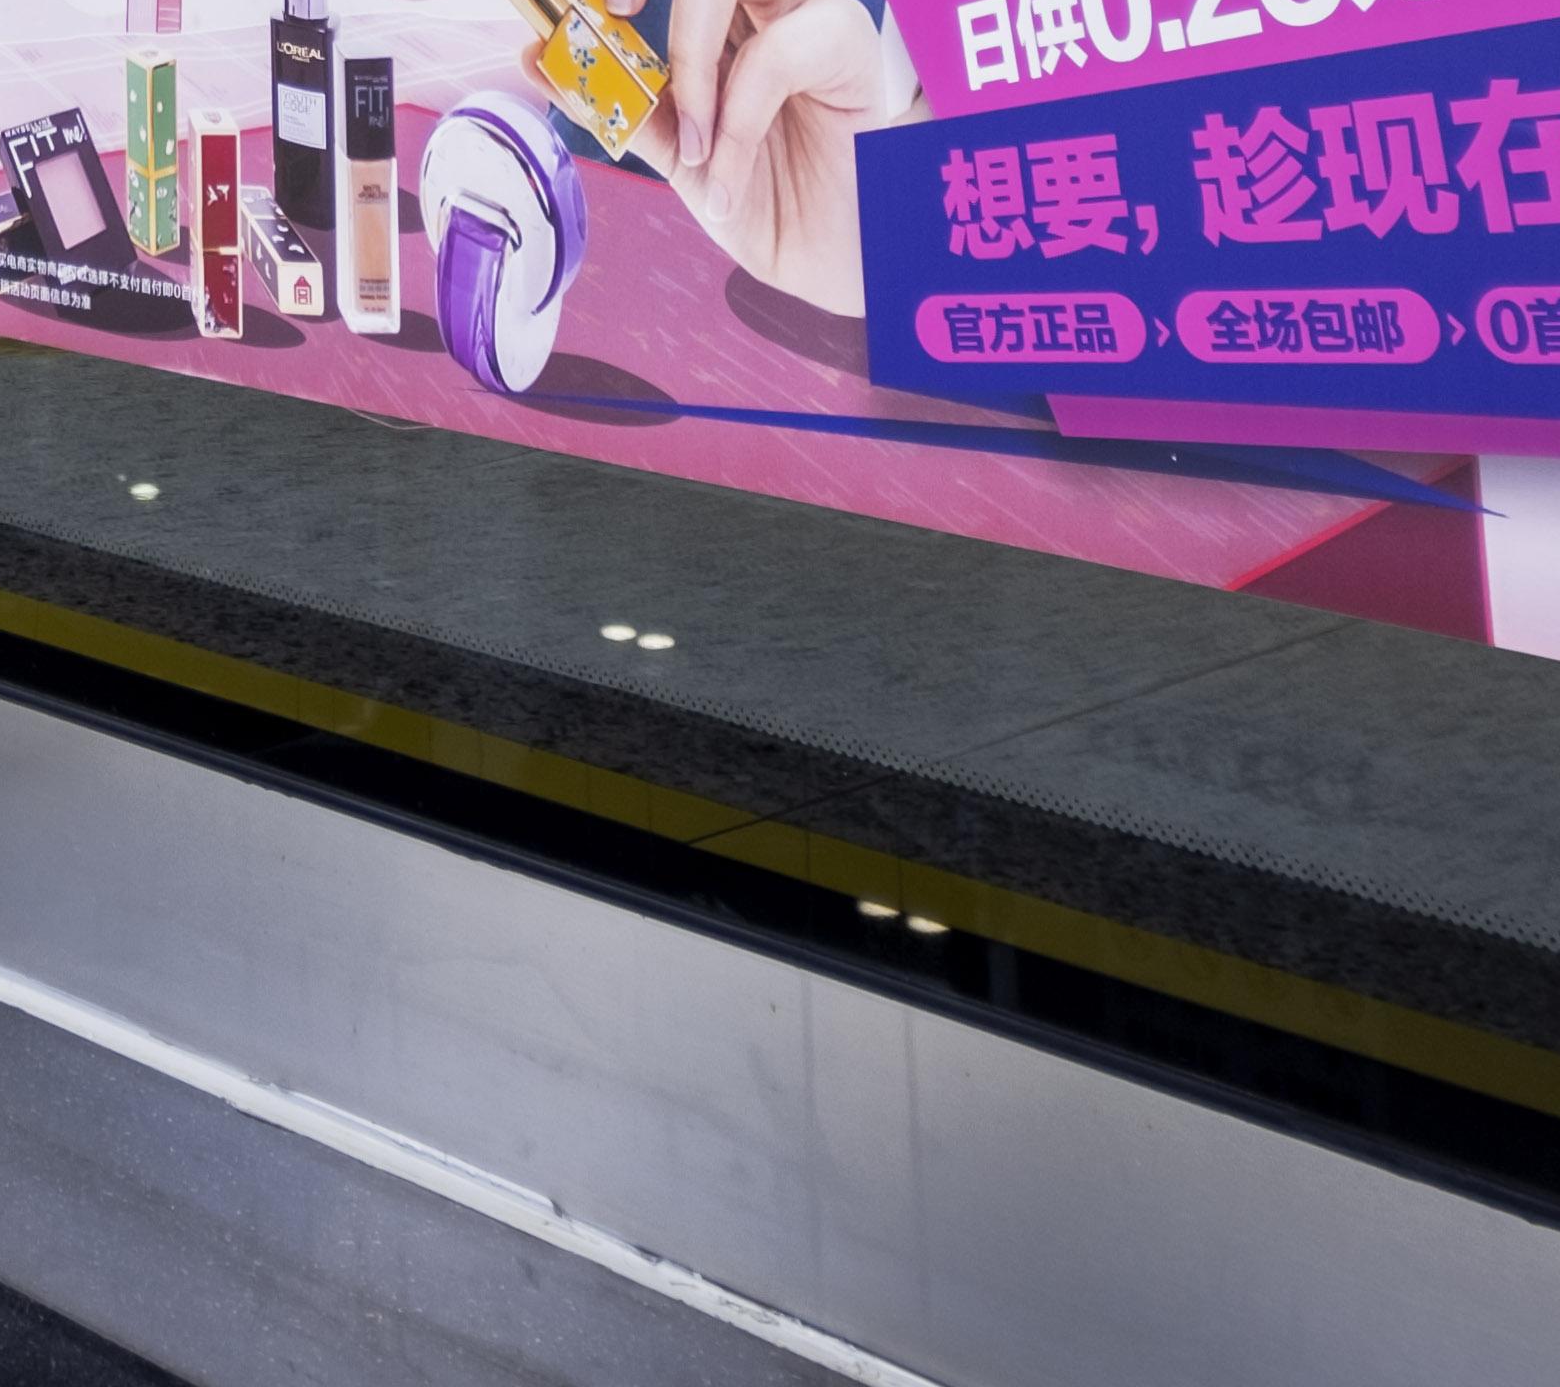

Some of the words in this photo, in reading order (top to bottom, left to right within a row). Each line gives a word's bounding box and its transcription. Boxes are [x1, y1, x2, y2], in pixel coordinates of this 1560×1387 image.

[355, 85, 389, 119] FIT
[7, 126, 59, 200] FIT
[943, 305, 1119, 355] 官方正品
[1205, 299, 1407, 356] 全场包邮
